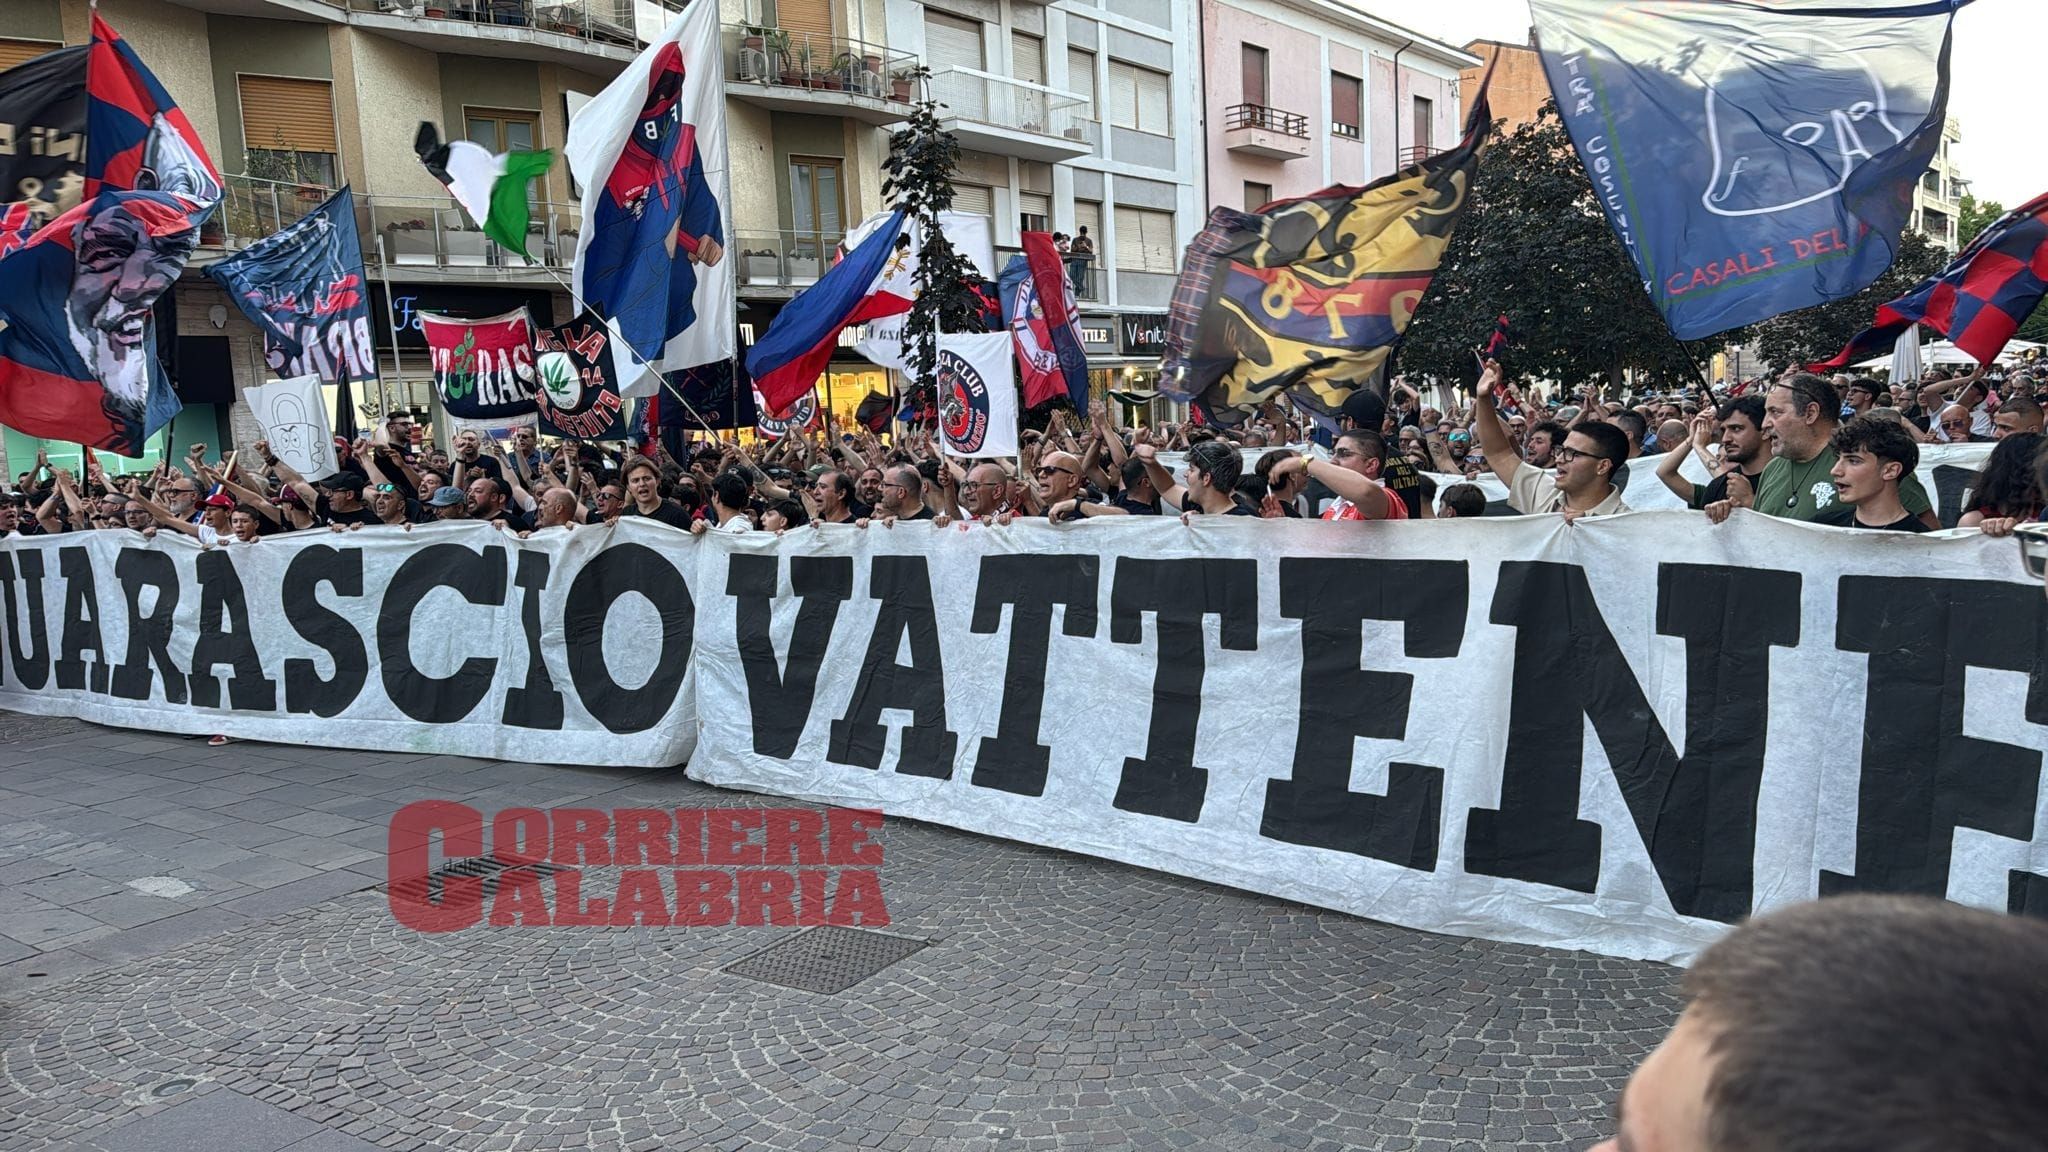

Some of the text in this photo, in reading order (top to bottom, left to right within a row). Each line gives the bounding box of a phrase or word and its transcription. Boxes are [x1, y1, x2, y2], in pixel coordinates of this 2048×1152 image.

[1667, 247, 1779, 295] CASALI
[954, 359, 984, 398] CLUB
[0, 543, 2048, 920] UARASCIO VATTENE
